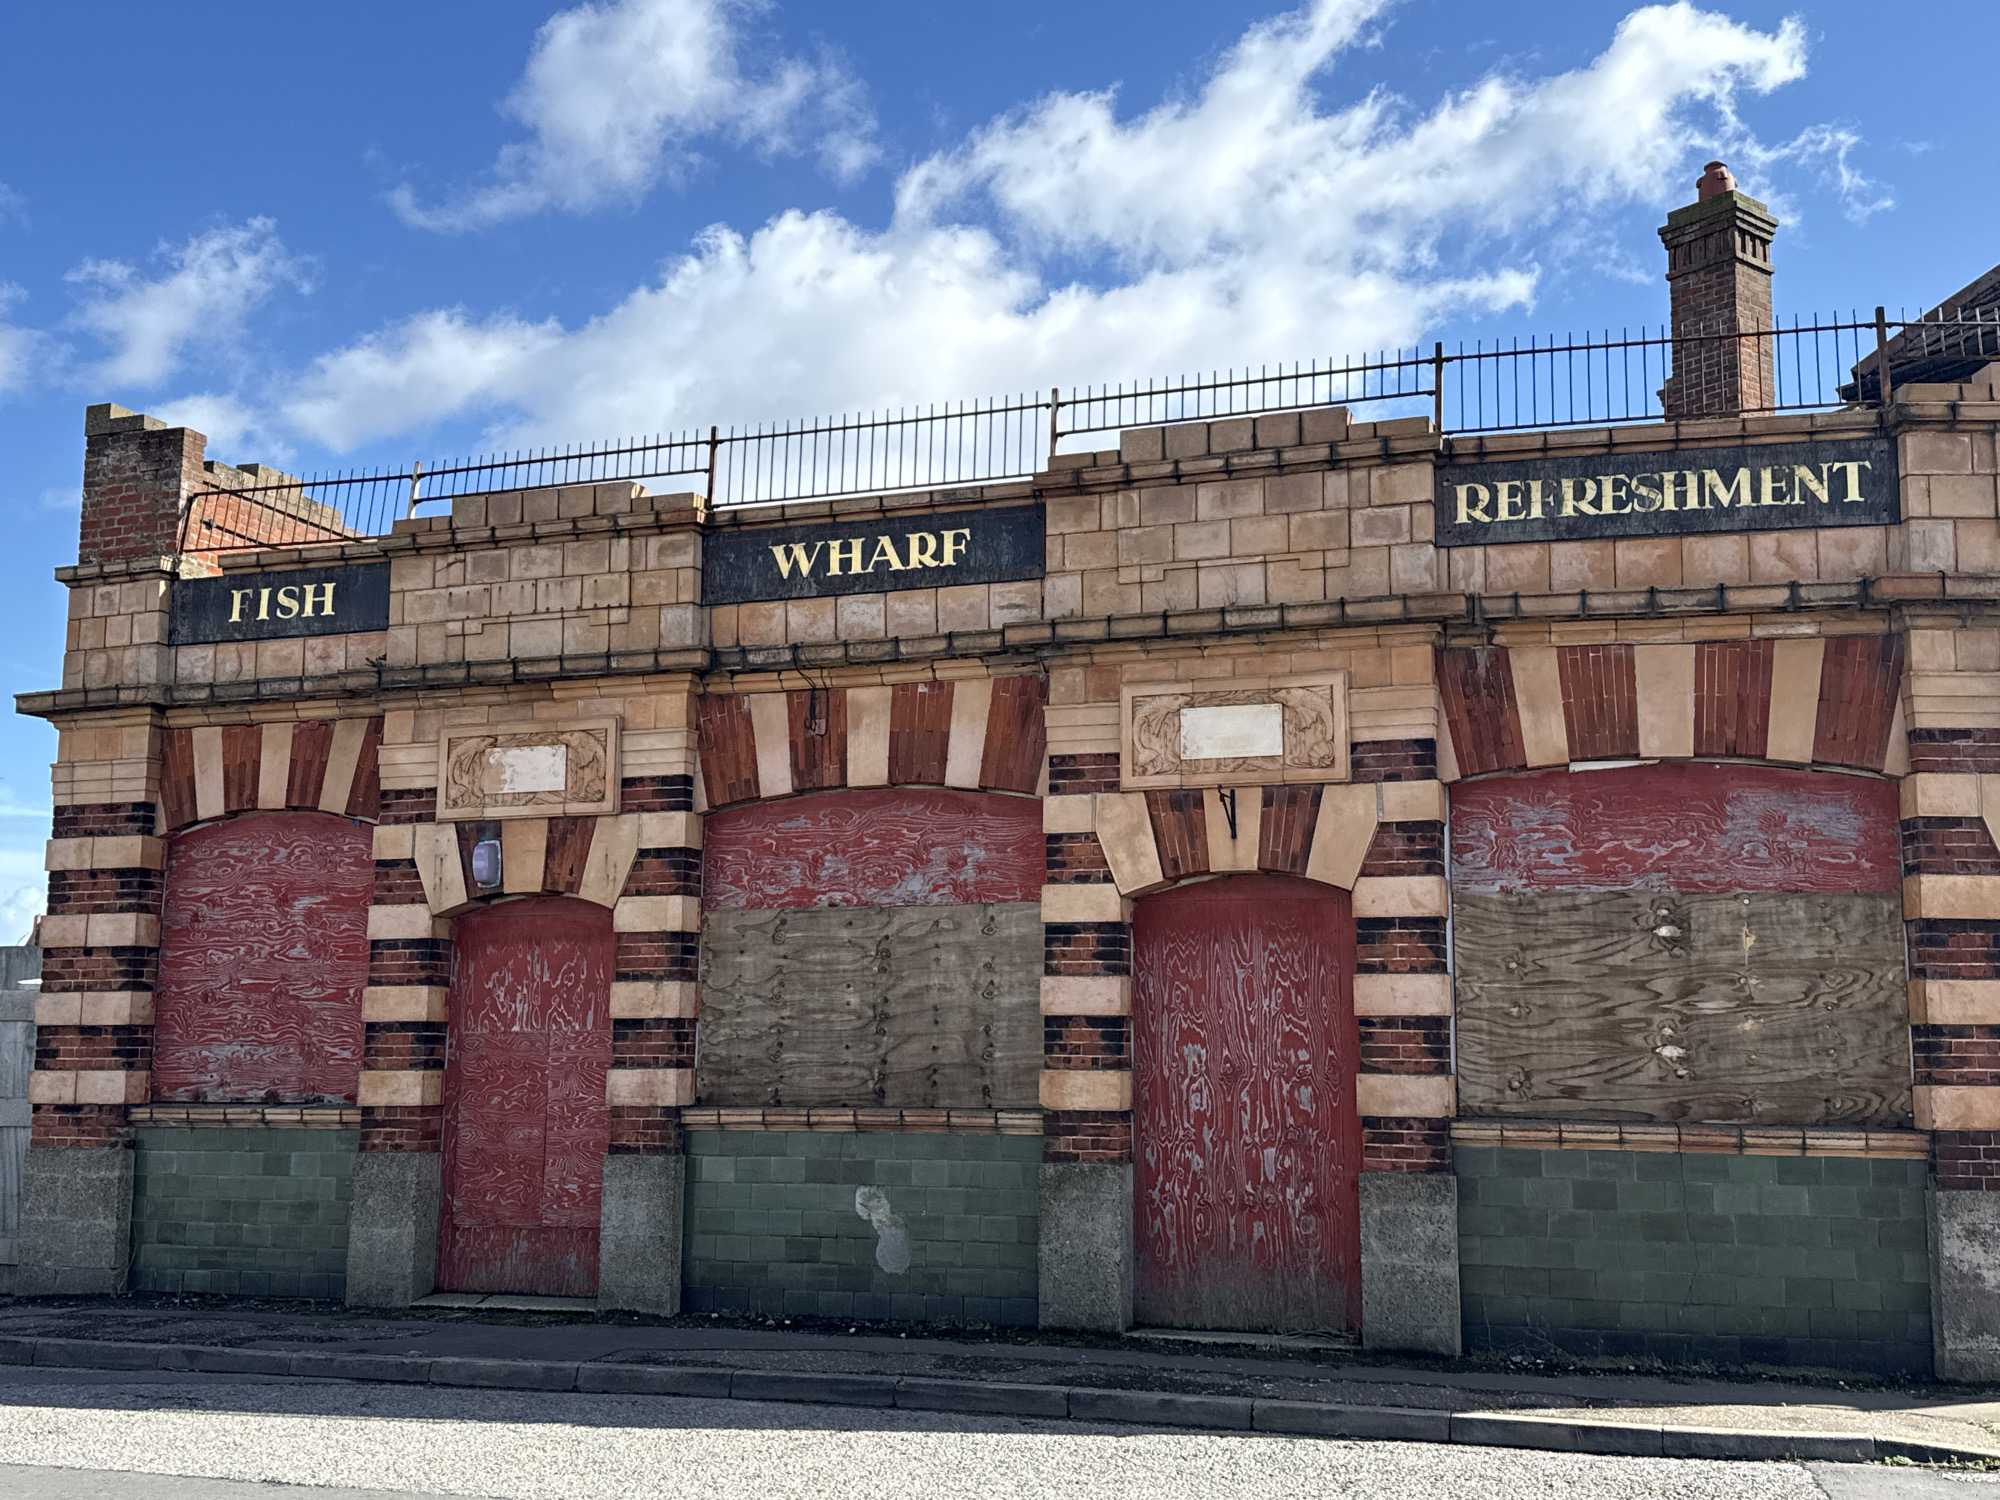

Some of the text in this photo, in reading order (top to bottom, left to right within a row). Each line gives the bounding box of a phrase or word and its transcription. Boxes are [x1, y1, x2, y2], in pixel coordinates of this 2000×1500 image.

[1453, 460, 1872, 525] REFRESHMENT
[769, 528, 971, 580] WHARF
[228, 582, 337, 623] FISH
